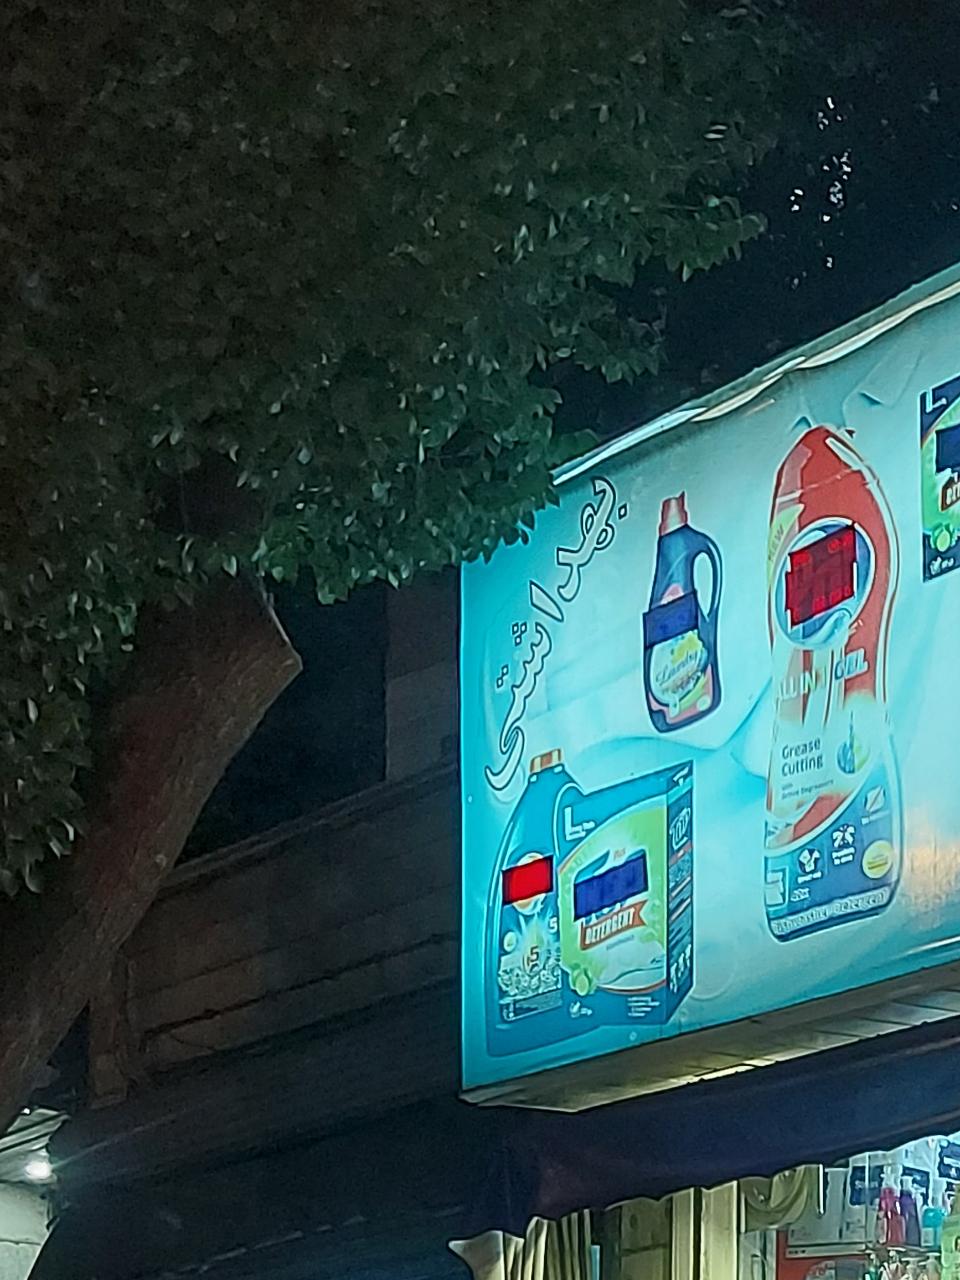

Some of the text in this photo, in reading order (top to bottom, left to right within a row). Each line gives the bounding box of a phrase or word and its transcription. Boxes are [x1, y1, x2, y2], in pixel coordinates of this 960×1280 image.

[781, 737, 821, 760] Grease
[781, 753, 824, 778] Cutting
[584, 906, 636, 945] DETERGENT
